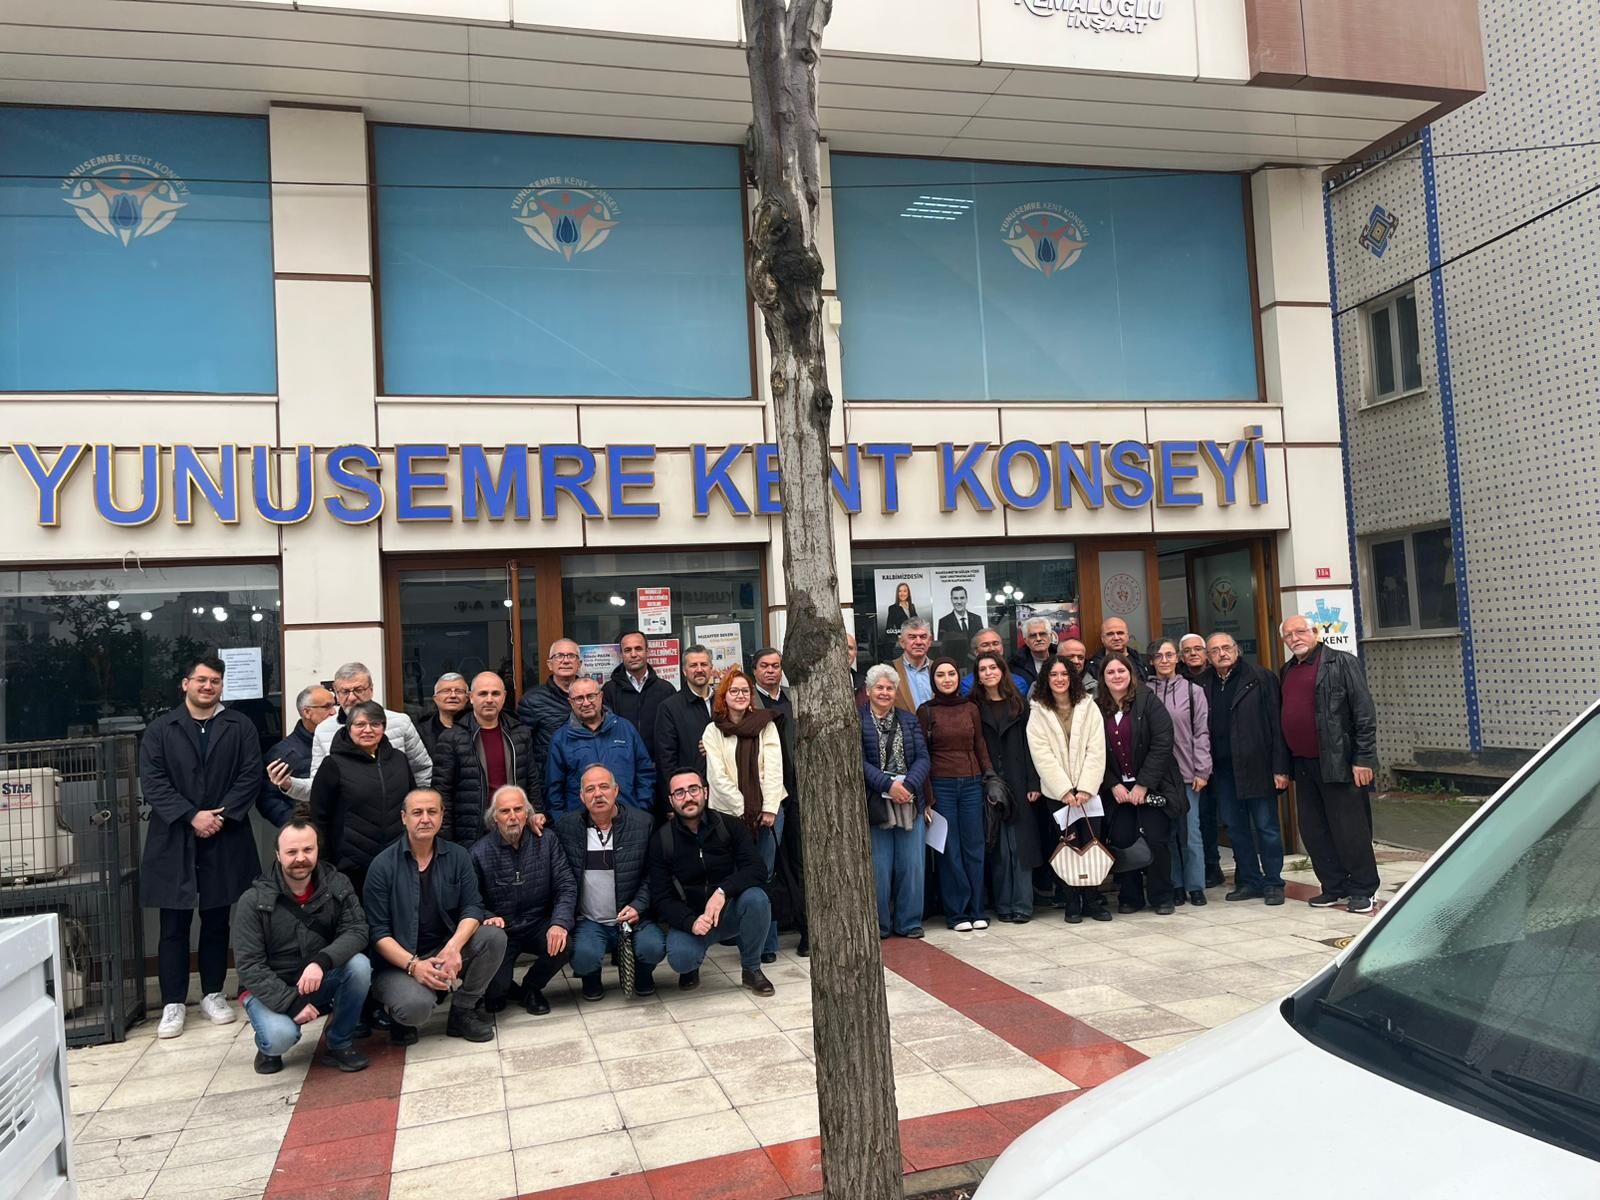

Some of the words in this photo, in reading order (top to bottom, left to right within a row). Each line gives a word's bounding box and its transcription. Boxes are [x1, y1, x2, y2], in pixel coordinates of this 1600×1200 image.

[1067, 14, 1147, 33] İNŞAAT
[8, 442, 660, 527] YUNUSEMRE
[937, 425, 1268, 512] KONSEYİ
[2, 783, 32, 795] STAR
